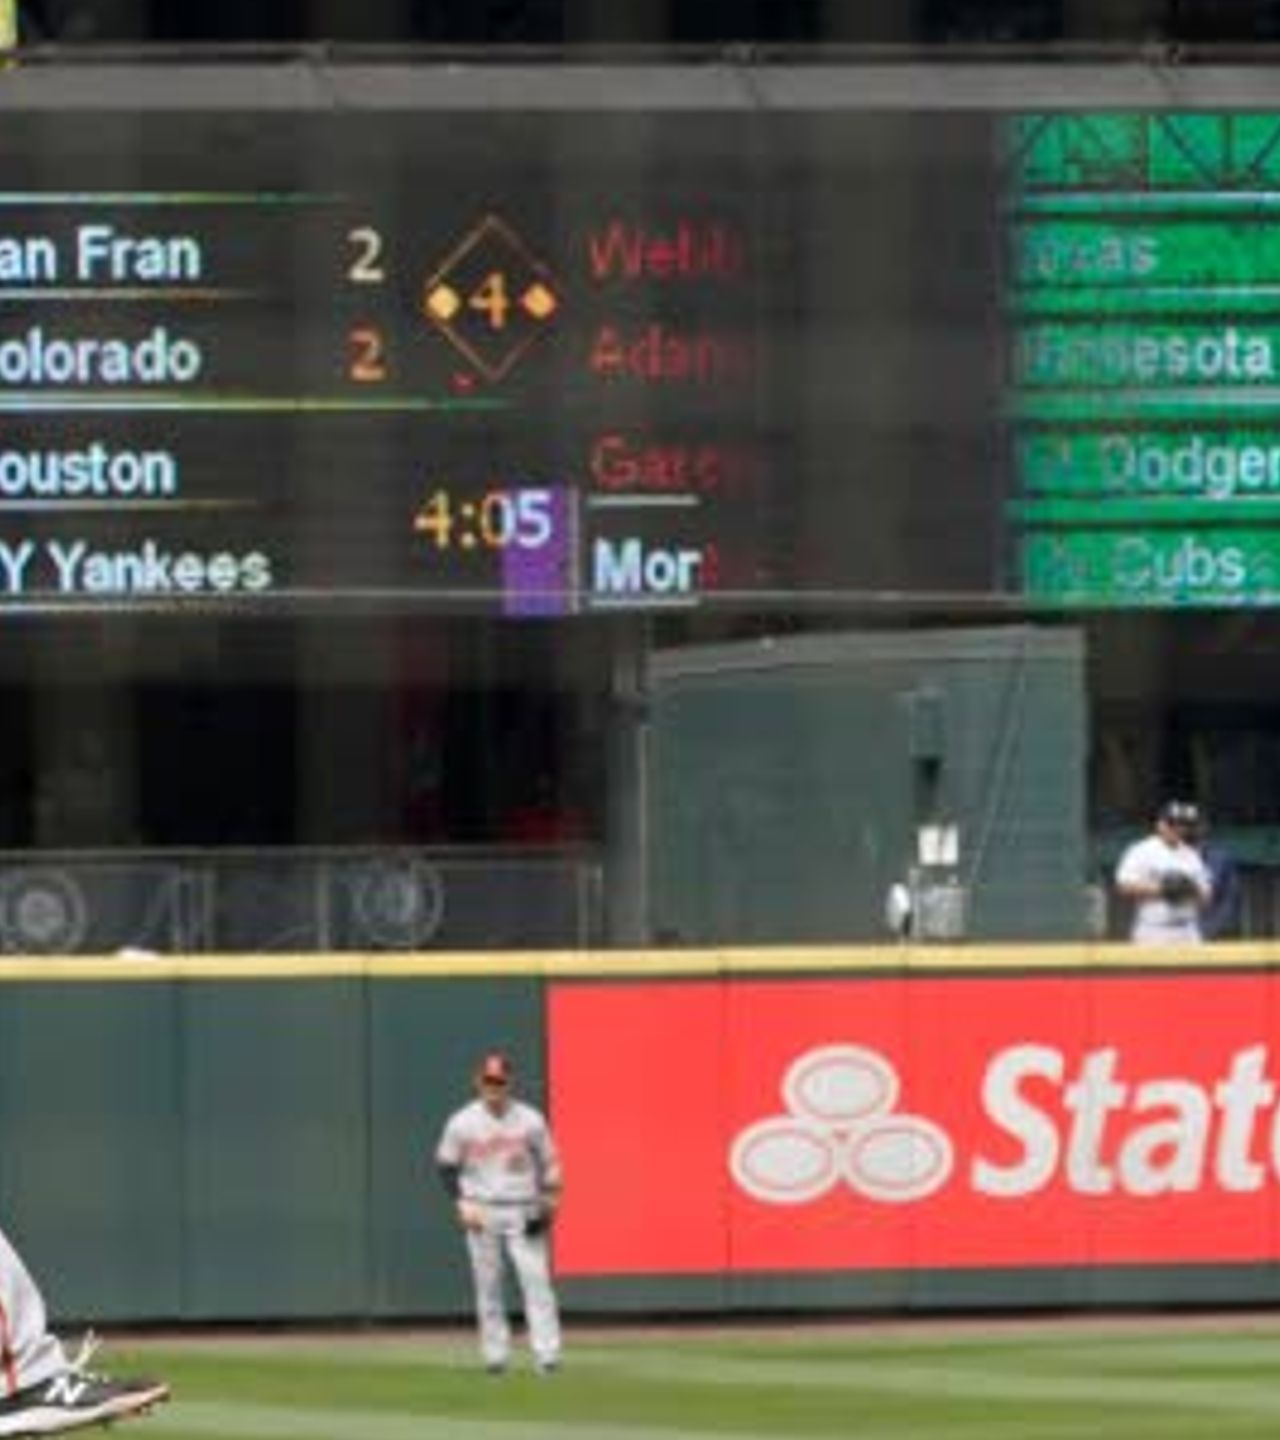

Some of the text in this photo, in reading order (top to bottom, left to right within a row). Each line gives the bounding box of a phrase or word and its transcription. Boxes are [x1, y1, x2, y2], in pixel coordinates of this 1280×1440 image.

[77, 224, 202, 281] Fran
[347, 225, 384, 282] 2
[469, 271, 509, 328] 4
[349, 329, 386, 383] 2
[413, 488, 554, 548] 4:05
[48, 538, 274, 592] Yankees
[1114, 535, 1246, 588] Cubs
